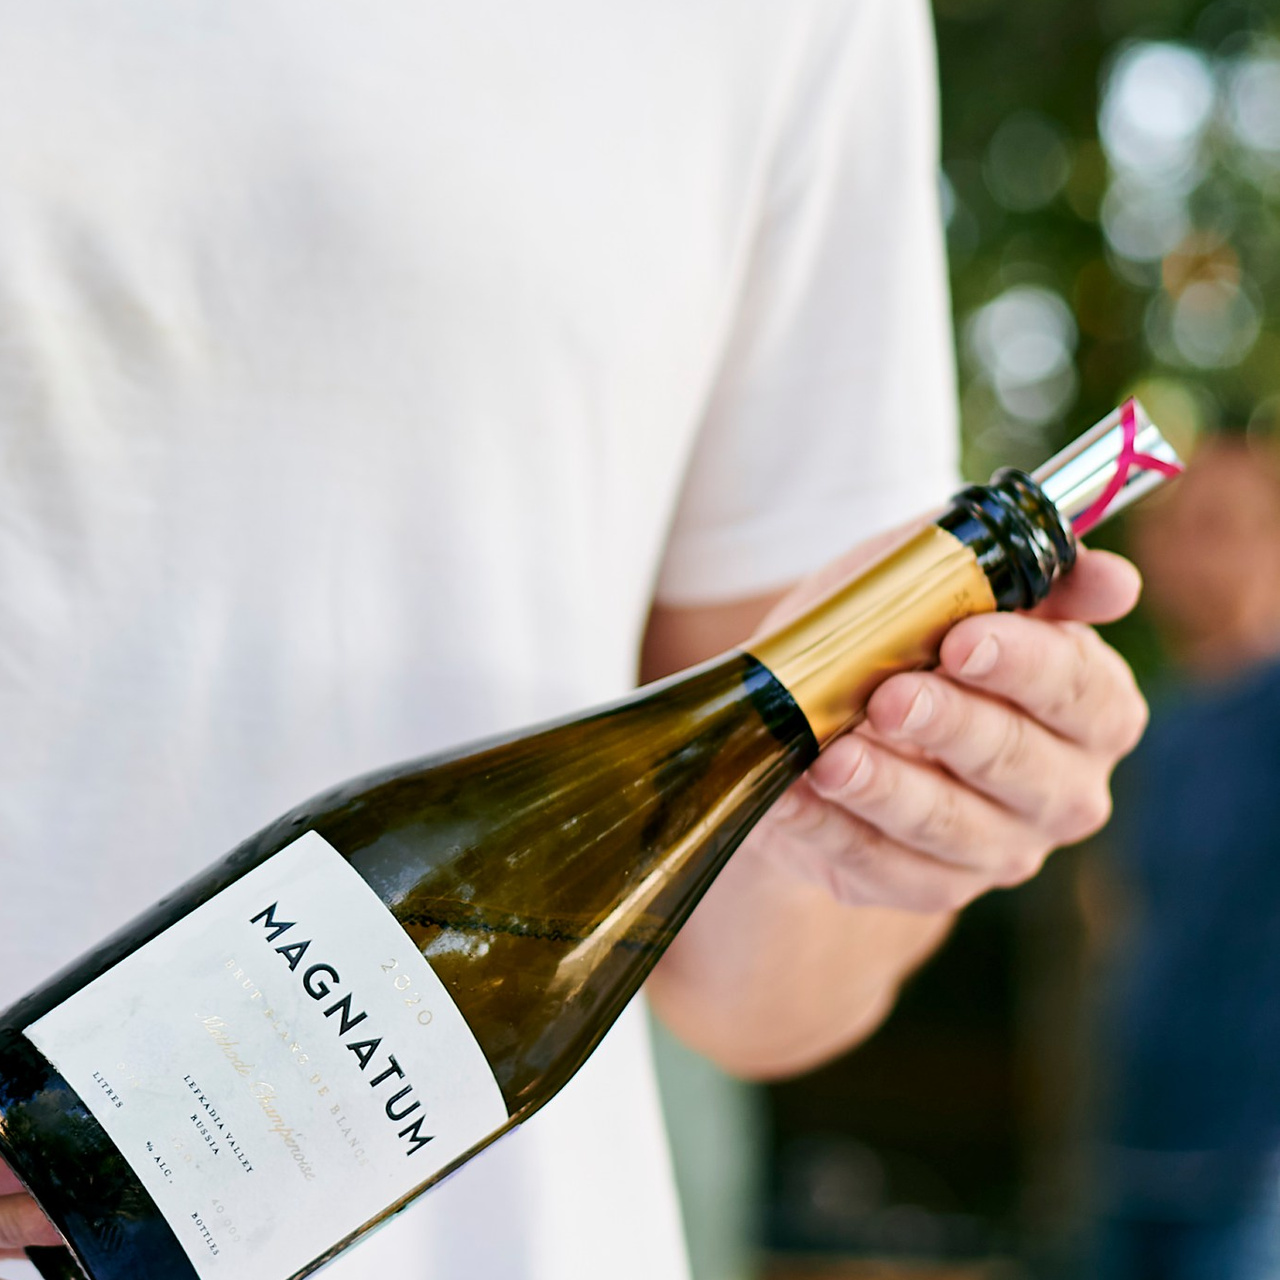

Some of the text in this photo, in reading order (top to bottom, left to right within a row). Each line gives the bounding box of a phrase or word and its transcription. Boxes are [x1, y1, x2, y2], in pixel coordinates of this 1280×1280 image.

[224, 958, 262, 1002] BRUT
[310, 1073, 330, 1097] DE
[248, 900, 437, 1158] MAGNATUM
[92, 1071, 124, 1109] LITRES
[183, 1074, 254, 1174] LEFKADIA VALLEY
[189, 1113, 220, 1157] RUSSIA
[190, 1211, 220, 1257] BOTTLES
